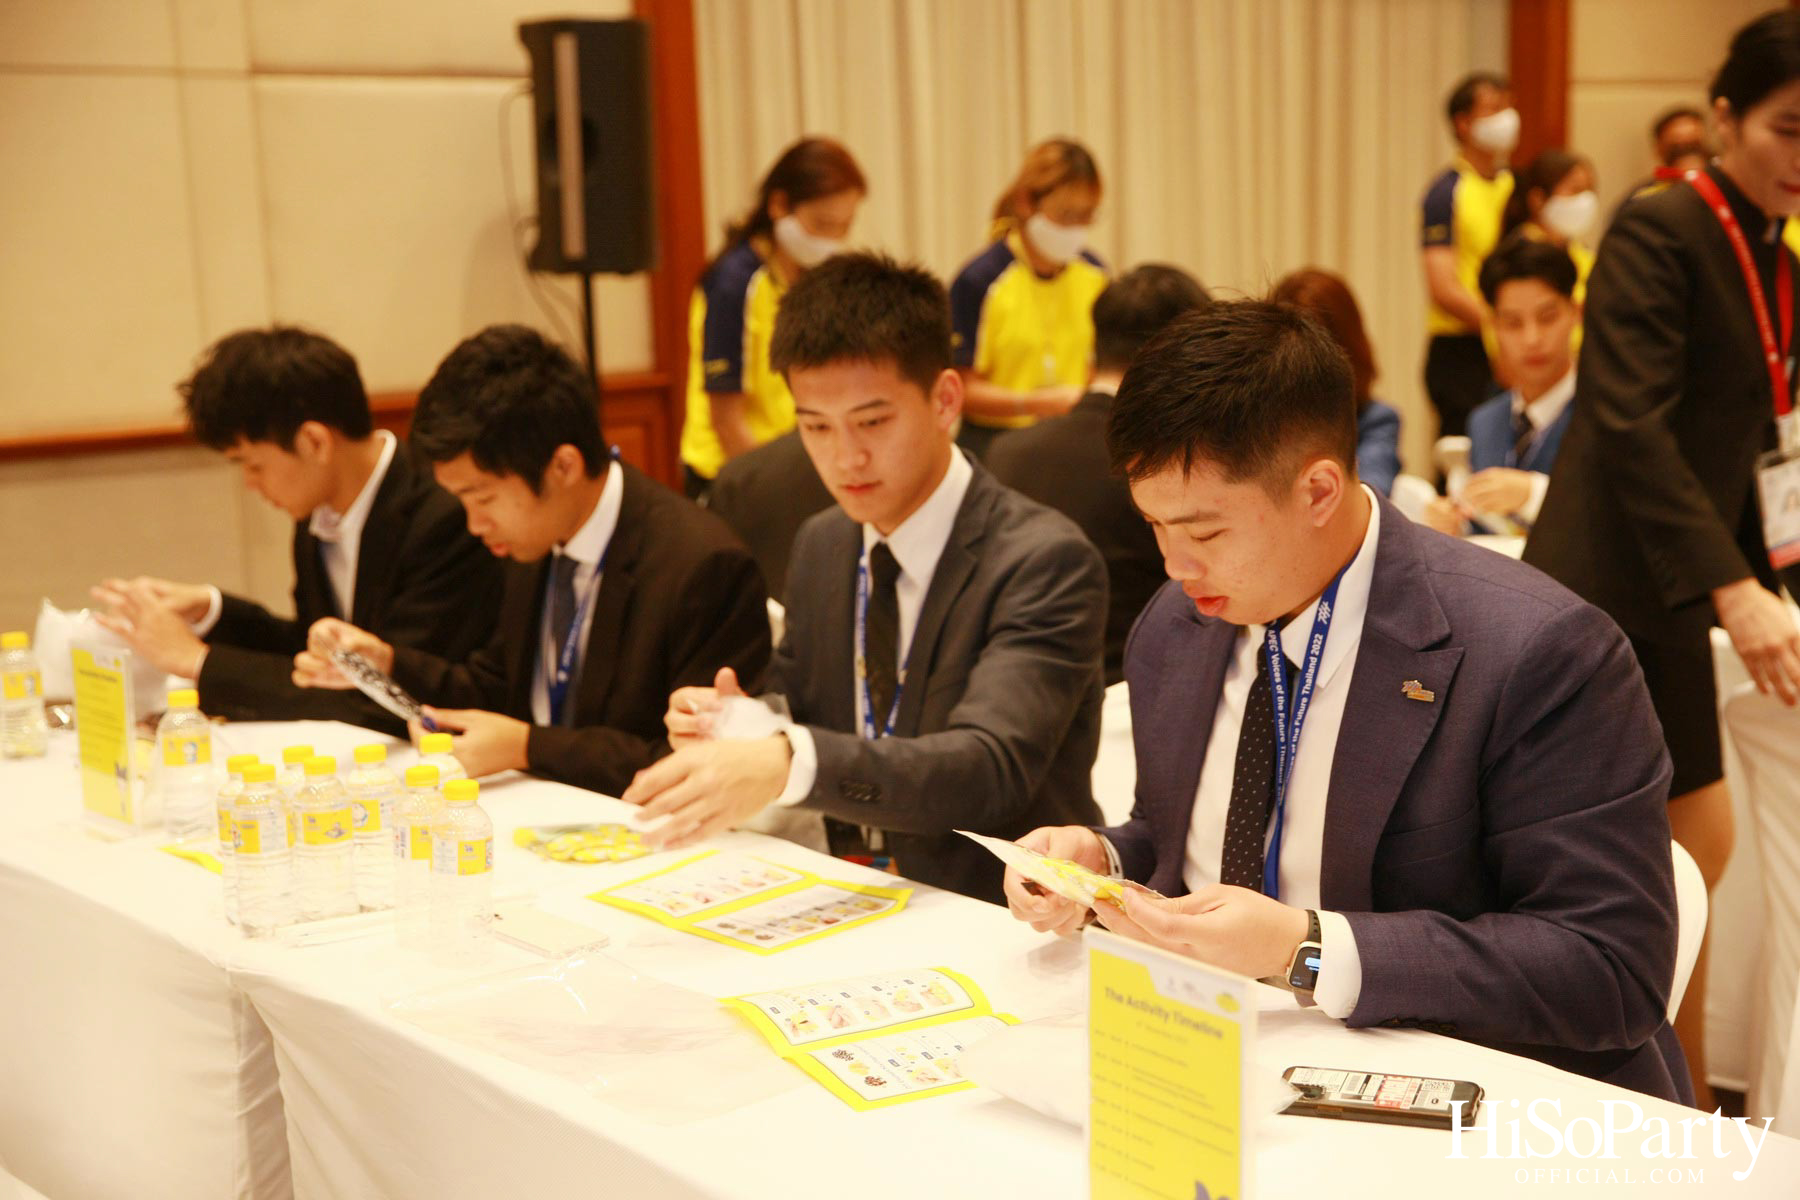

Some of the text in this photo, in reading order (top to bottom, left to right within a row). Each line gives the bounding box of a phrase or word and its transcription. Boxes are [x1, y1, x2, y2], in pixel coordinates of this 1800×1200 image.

[1268, 630, 1279, 652] APEC
[1310, 633, 1325, 656] 2022
[1271, 653, 1282, 683] Voices
[1301, 656, 1319, 696] Thailand
[1275, 684, 1285, 695] of
[1277, 696, 1285, 711] the
[1294, 697, 1309, 726] Future
[1278, 712, 1286, 743] Future
[1292, 727, 1301, 743] the
[1105, 986, 1124, 1004] The
[1127, 995, 1170, 1024] Activity
